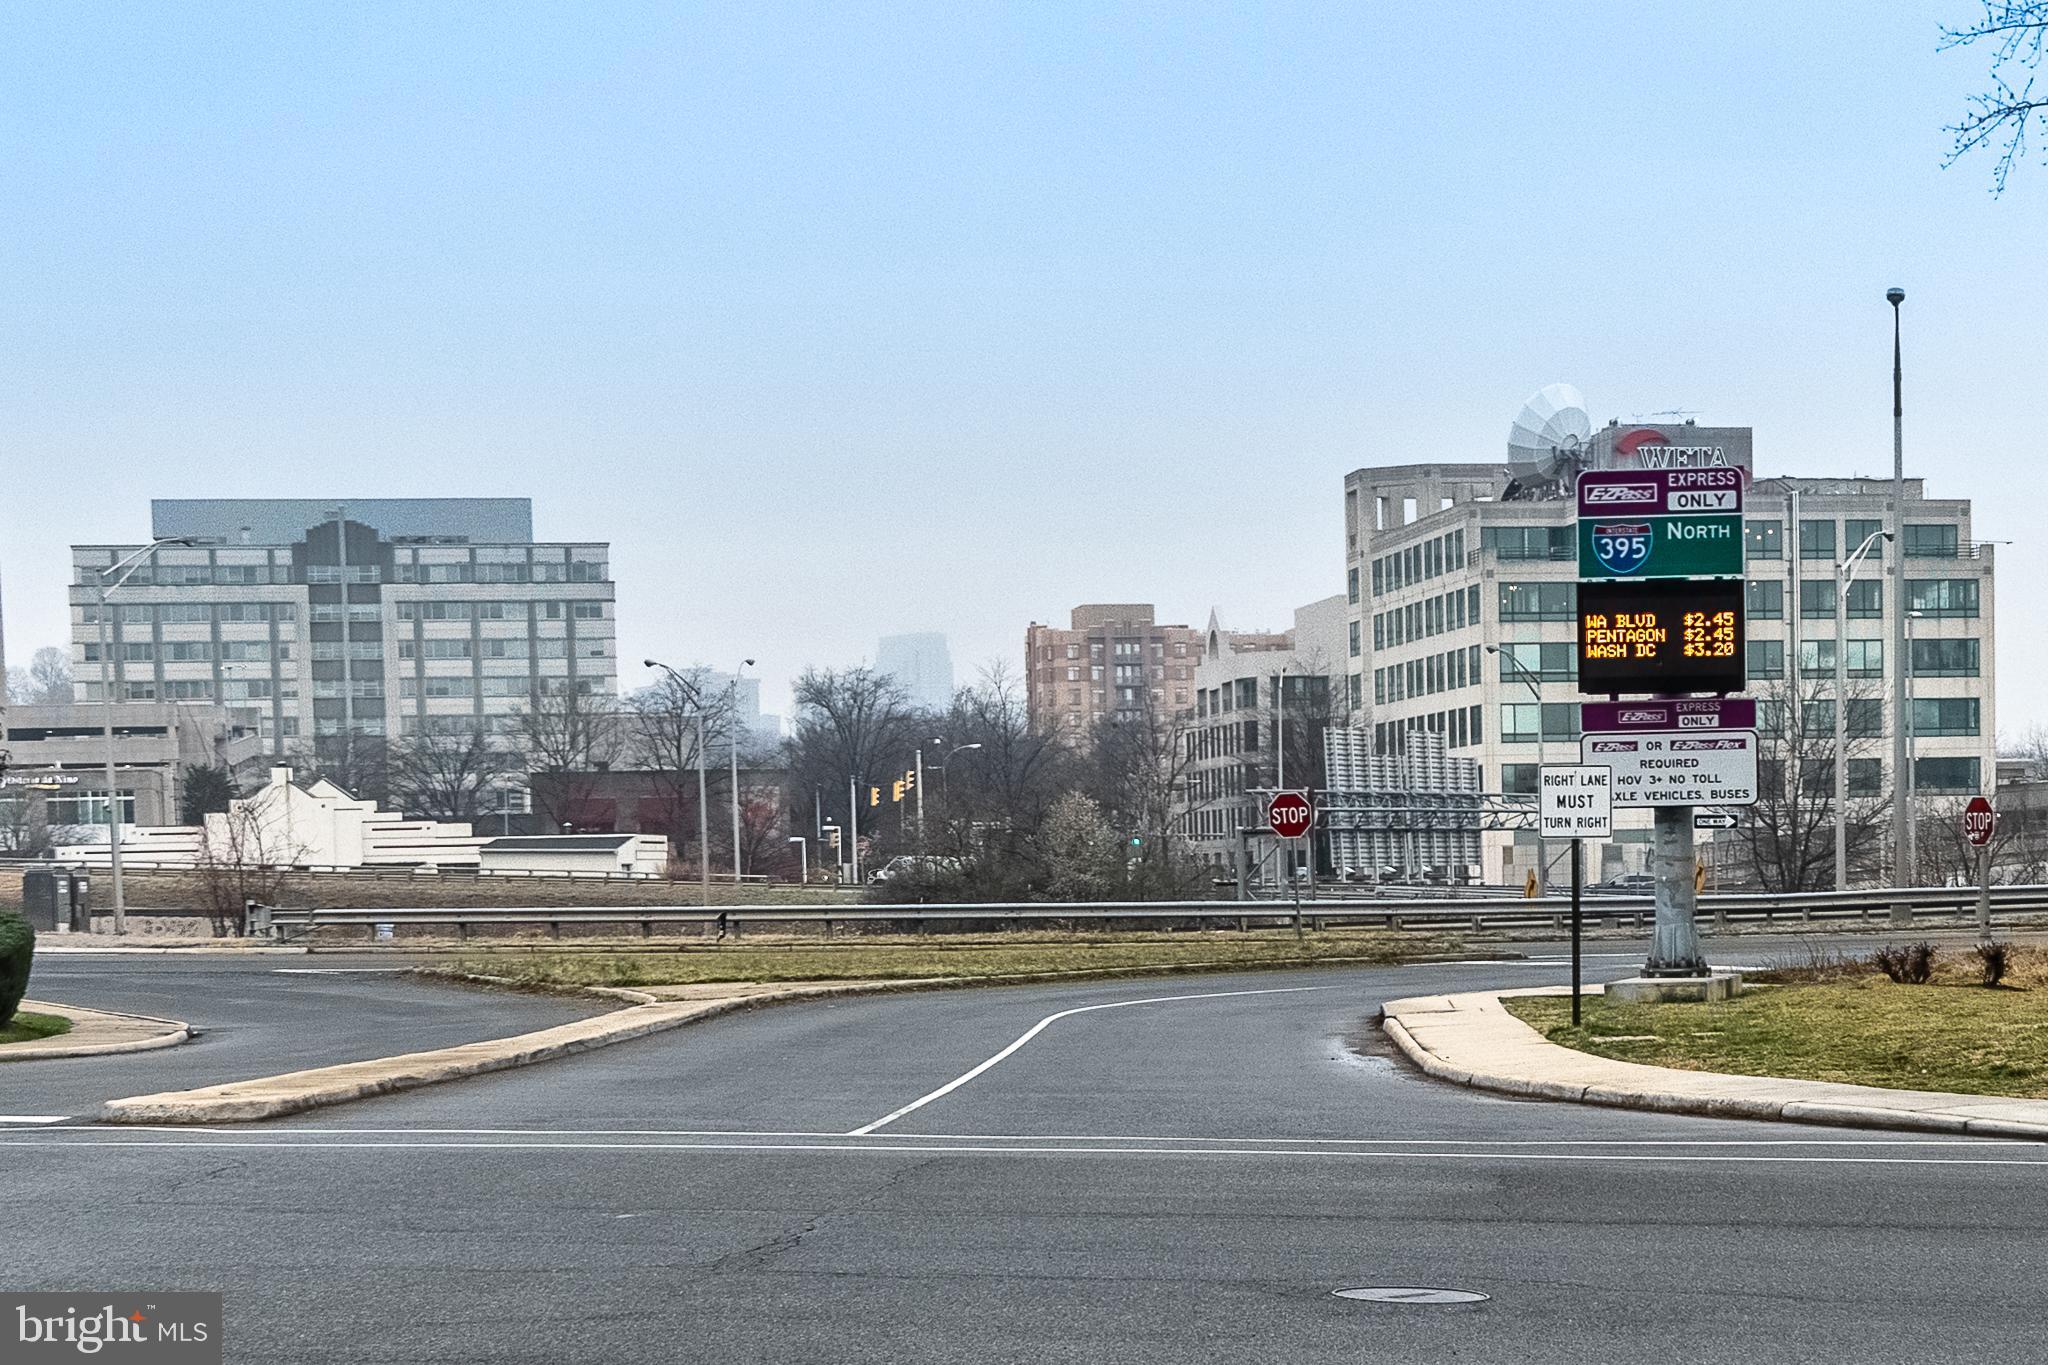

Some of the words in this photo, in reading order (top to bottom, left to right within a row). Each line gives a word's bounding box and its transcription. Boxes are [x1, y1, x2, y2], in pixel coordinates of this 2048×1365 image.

[1637, 447, 1729, 469] WETA
[1668, 471, 1736, 487] EXPRESS
[1677, 493, 1728, 508] ONLY
[1606, 527, 1639, 535] INTERSTATE
[1600, 538, 1646, 559] 395
[1586, 614, 1607, 629] WA
[1616, 613, 1656, 628] BLVD
[1684, 612, 1734, 627] $2.45
[1586, 629, 1666, 643] PENTAGON
[1684, 627, 1734, 642] $2.45
[1586, 644, 1627, 659] WASH
[1636, 643, 1656, 657] DC
[1684, 642, 1734, 657] $3.20
[1676, 702, 1721, 712] EXPRESS
[1682, 716, 1715, 727] ONLY
[1646, 742, 1662, 751] OR
[1715, 740, 1741, 749] Flex
[1640, 759, 1699, 769] REQUIRED
[1544, 775, 1574, 787] RIGHT
[1580, 774, 1608, 786] LANE
[1617, 775, 1642, 785] HOV
[1649, 775, 1662, 784] 3+
[1669, 775, 1685, 784] NO
[1692, 774, 1722, 783] TOLL
[1556, 794, 1594, 809] MUST
[1611, 791, 1637, 801] XLE
[1710, 789, 1750, 799] BUSES
[1272, 807, 1308, 824] STOP
[1543, 817, 1571, 829] TURN
[1577, 816, 1608, 828] RIGHT
[1966, 812, 1992, 830] STOP
